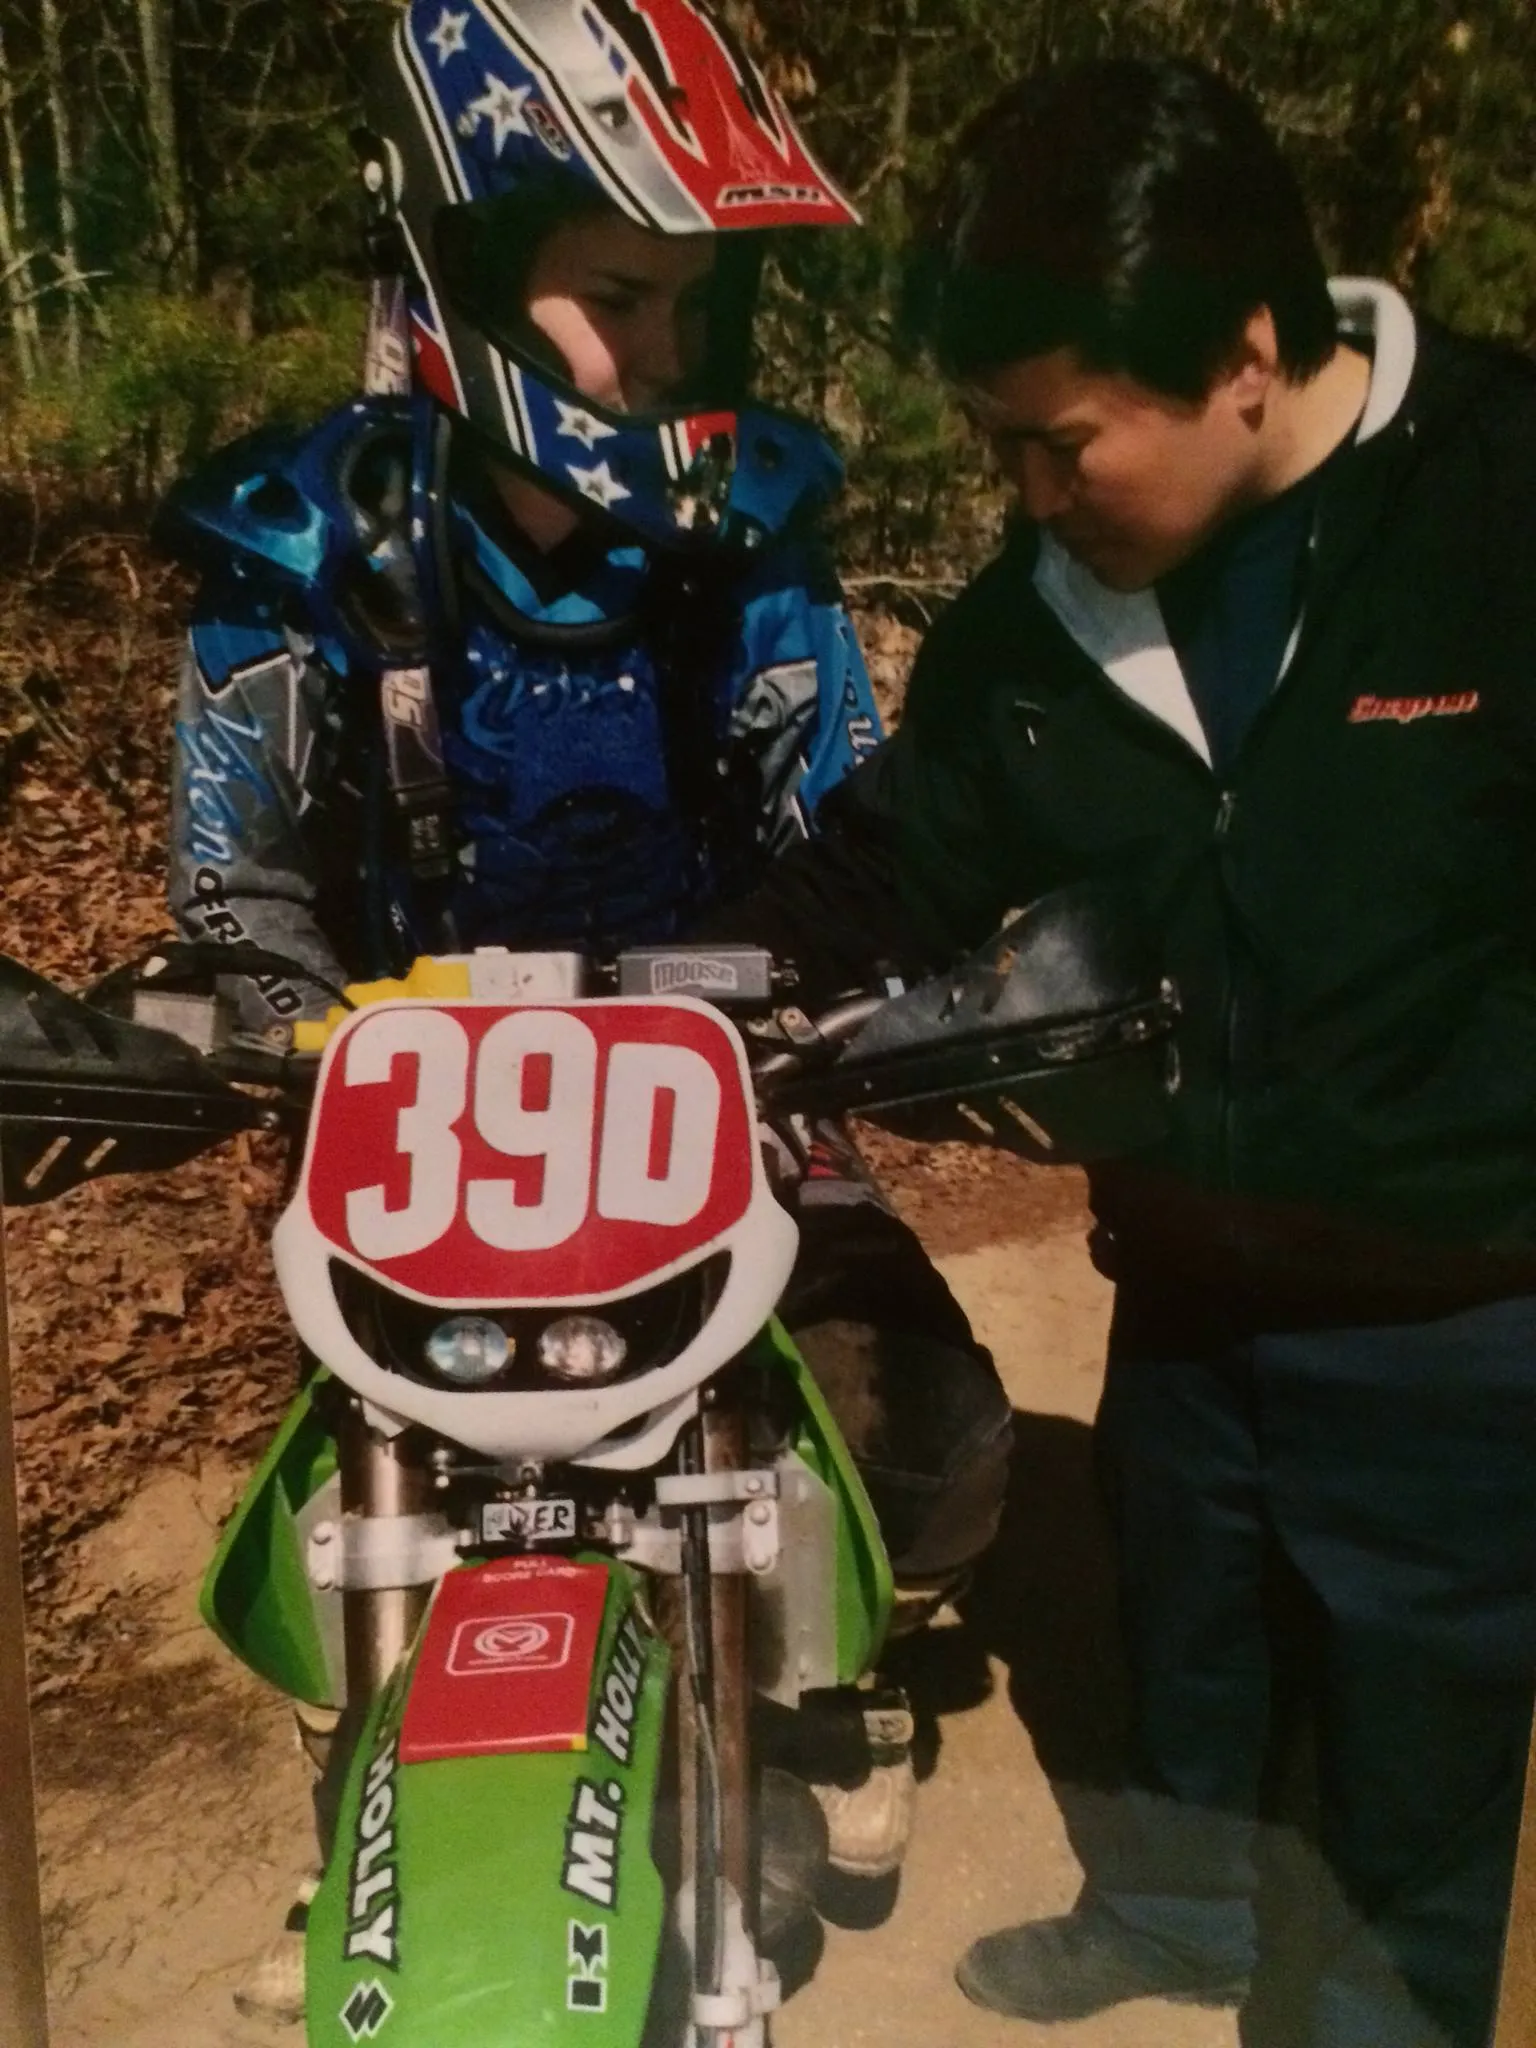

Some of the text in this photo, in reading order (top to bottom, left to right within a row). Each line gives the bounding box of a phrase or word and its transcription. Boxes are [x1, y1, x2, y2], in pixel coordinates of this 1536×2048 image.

[345, 1008, 721, 1261] 39D
[348, 1737, 396, 1962] HOLLY
[565, 1616, 646, 1905] MT. HOLLY
